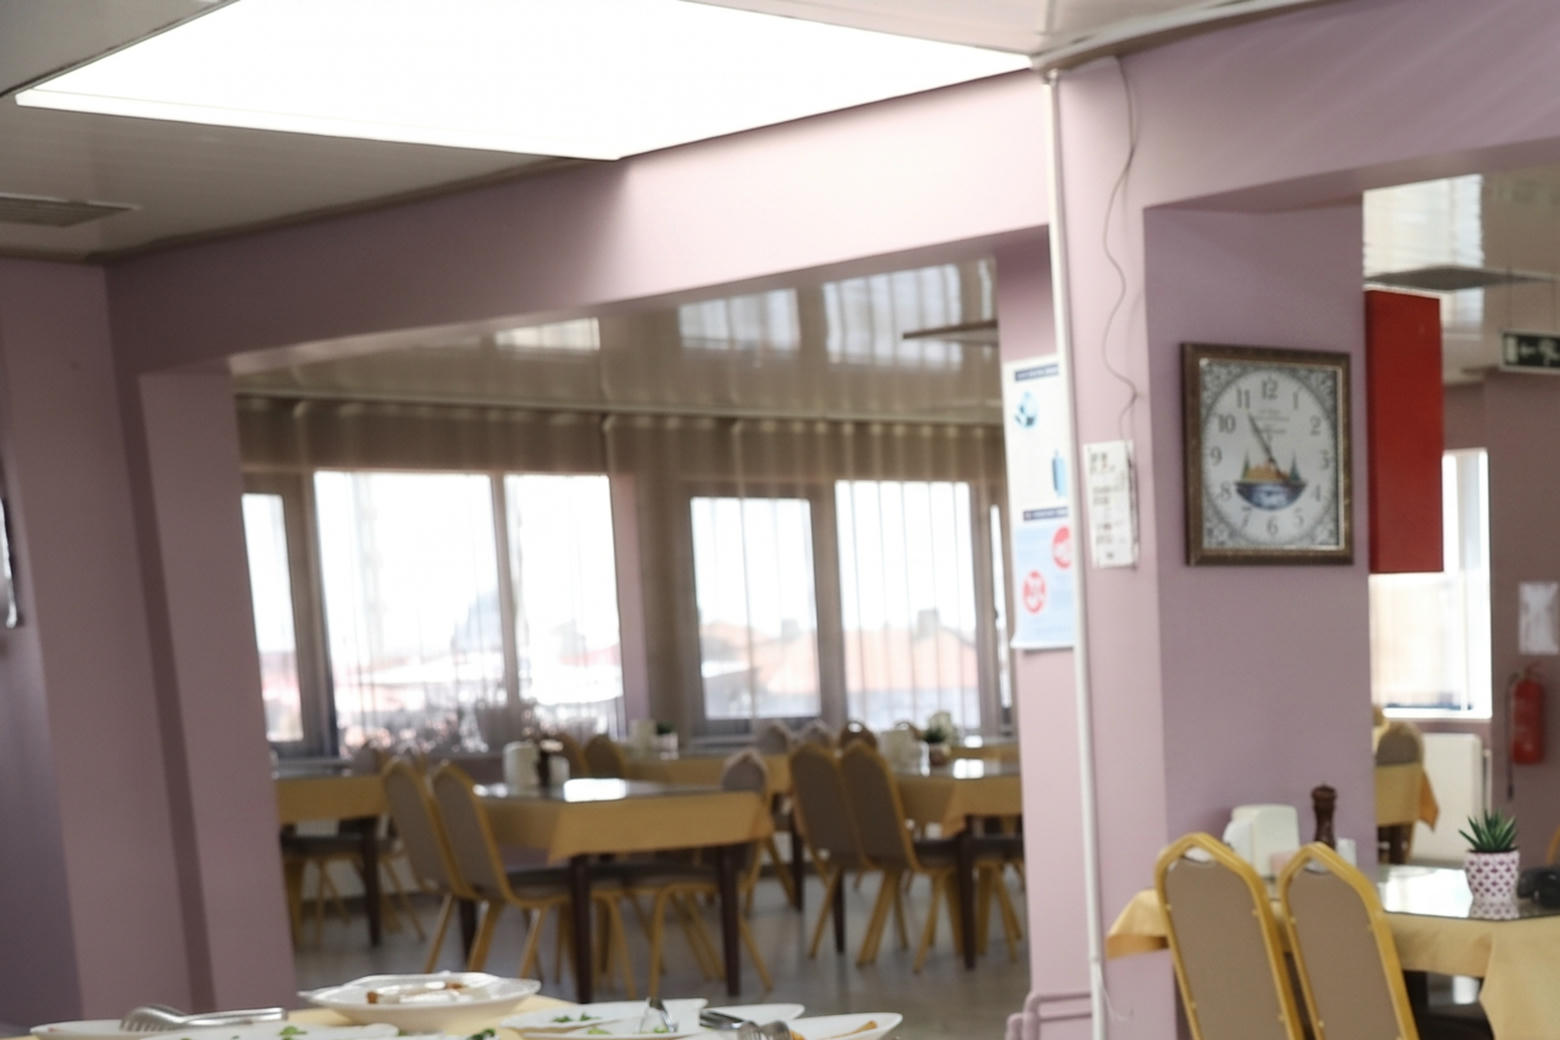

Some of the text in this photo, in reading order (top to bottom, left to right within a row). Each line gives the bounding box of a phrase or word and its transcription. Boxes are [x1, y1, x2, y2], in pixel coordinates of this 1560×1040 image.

[1236, 389, 1250, 409] 11
[1262, 378, 1278, 400] 12
[1218, 414, 1236, 434] 10
[1310, 415, 1322, 436] 2
[1210, 447, 1222, 466] 9
[1320, 450, 1330, 470] 3
[1220, 482, 1232, 500] 8
[1311, 484, 1322, 502] 4
[1266, 518, 1279, 536] 6
